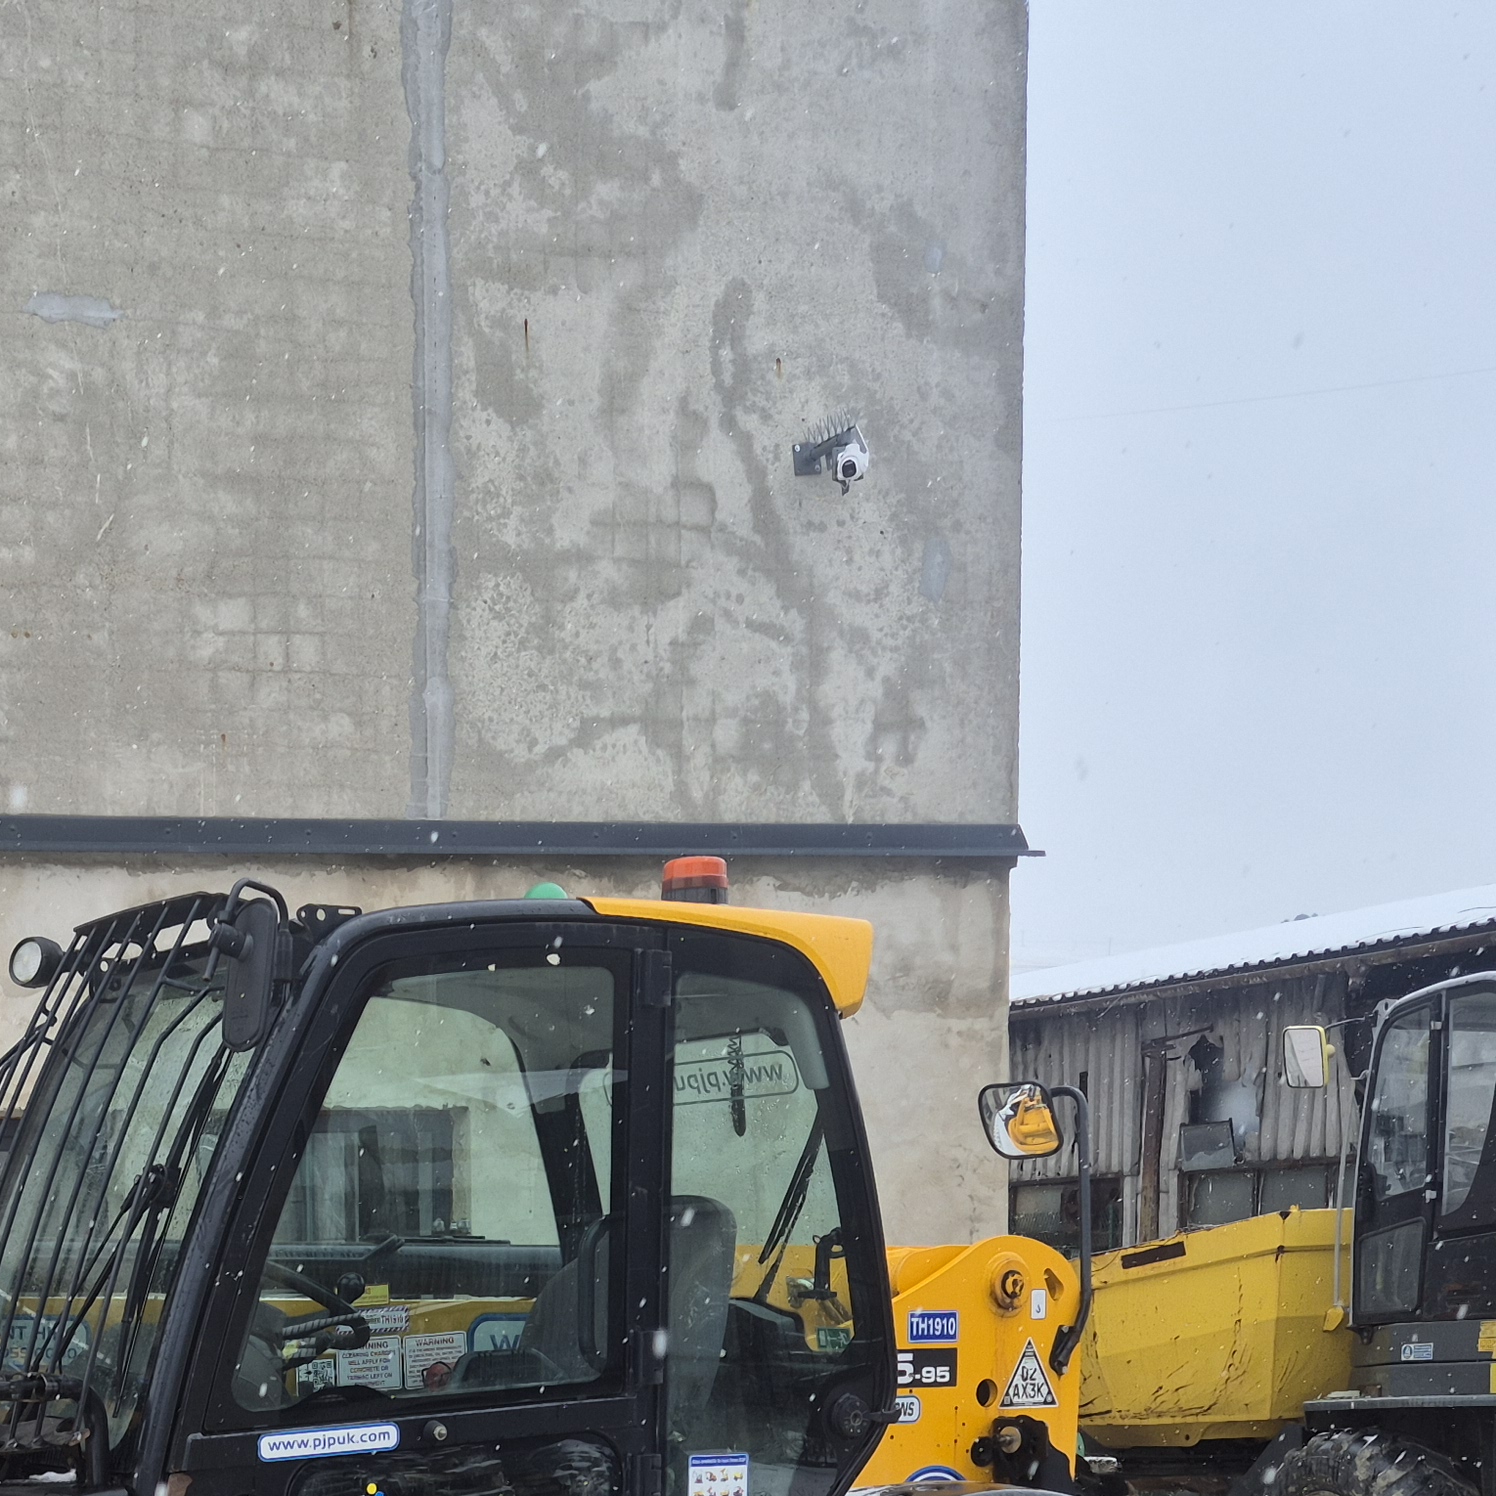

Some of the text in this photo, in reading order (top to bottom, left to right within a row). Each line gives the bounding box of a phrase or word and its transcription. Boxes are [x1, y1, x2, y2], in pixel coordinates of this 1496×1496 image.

[911, 1317, 956, 1336] TH1910
[415, 1336, 454, 1347] WARNING
[1013, 1383, 1045, 1399] AX3K
[268, 1431, 390, 1453] www.pjpuk.com
